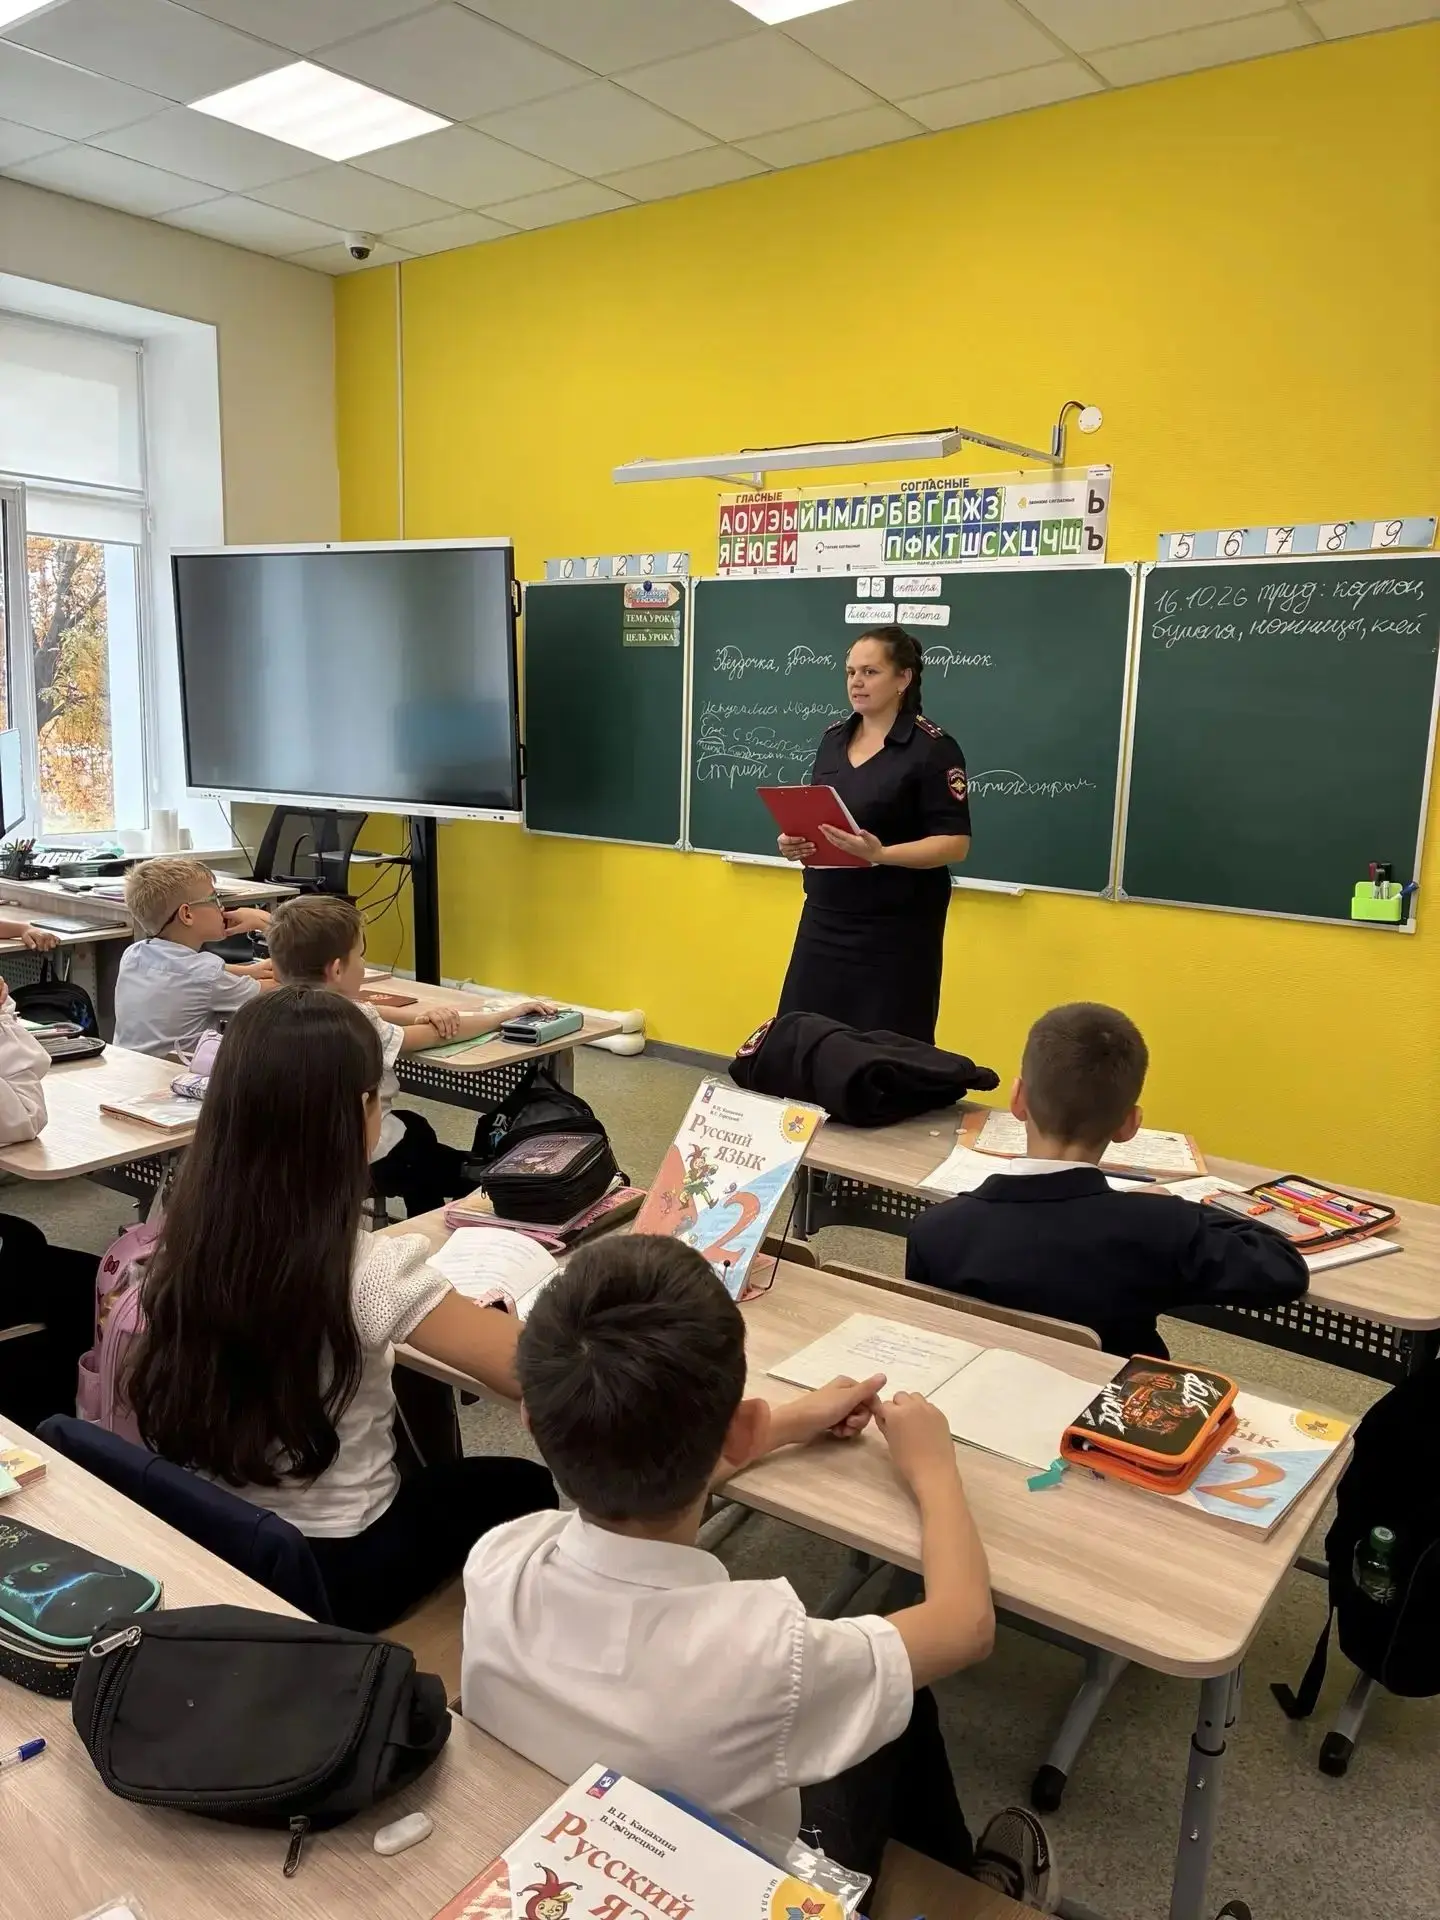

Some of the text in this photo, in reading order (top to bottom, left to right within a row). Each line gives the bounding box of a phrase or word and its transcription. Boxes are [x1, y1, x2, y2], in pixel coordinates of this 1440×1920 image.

[736, 492, 783, 503] ГЛАСНЫЕ
[901, 478, 970, 492] СОГЛАСНЫЕ
[1174, 520, 1403, 559] 5 6 7 8 9
[564, 552, 683, 578] 0 1 2 3 4
[1154, 585, 1248, 613] 16.10.26
[626, 614, 648, 623] ТЕМА
[626, 633, 647, 642] ЦЕЛЬ
[688, 1113, 753, 1148] Русский
[701, 1191, 761, 1268] 2
[1196, 1456, 1287, 1510] 2
[619, 1826, 667, 1859] Горецкий
[630, 1819, 678, 1853] Канакина
[540, 1810, 696, 1920] Русский
